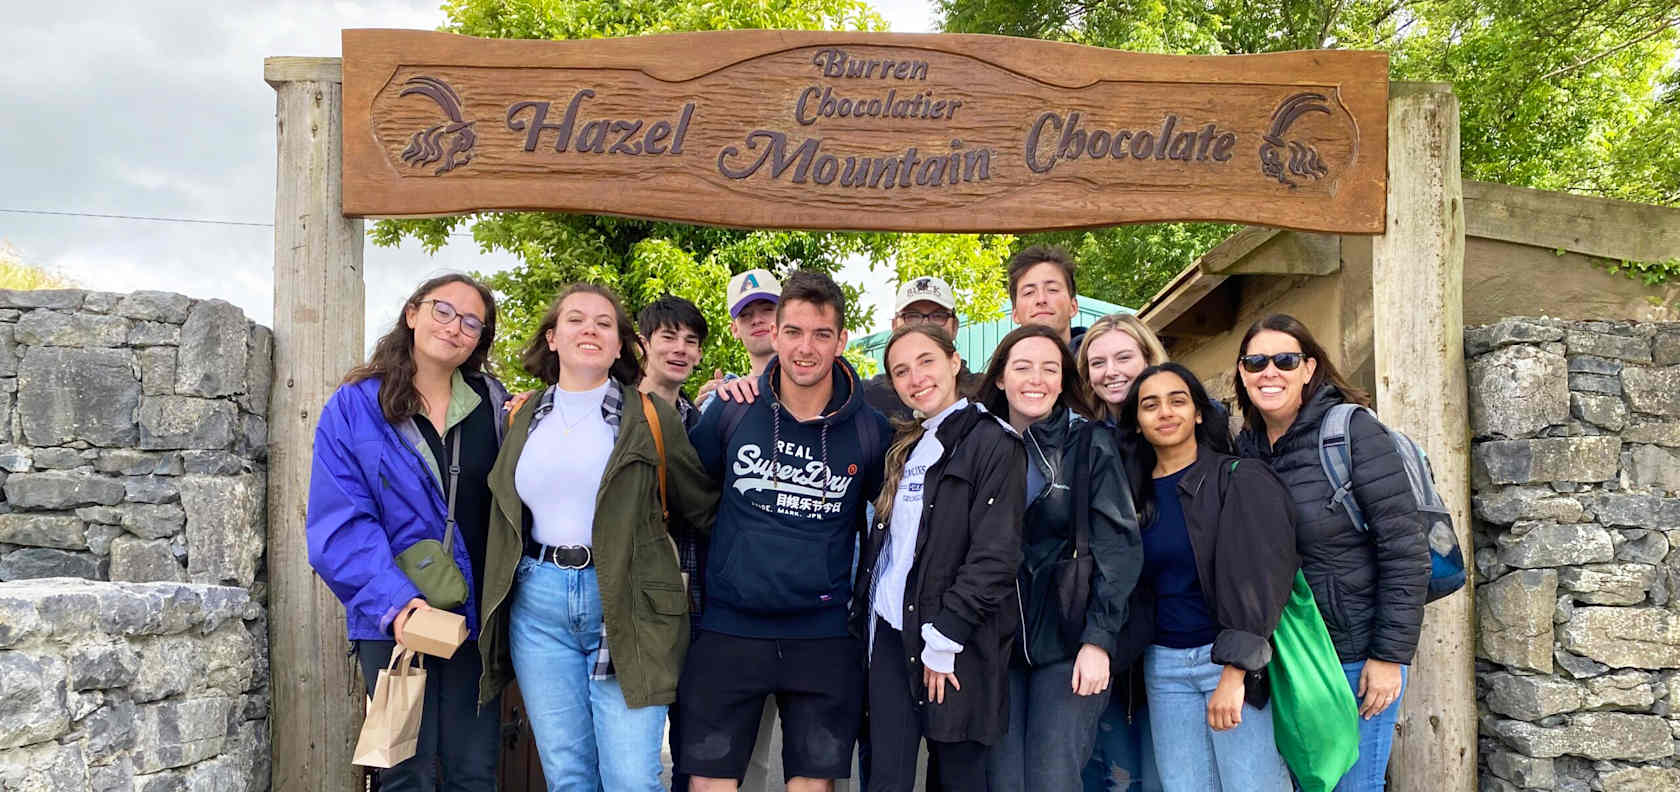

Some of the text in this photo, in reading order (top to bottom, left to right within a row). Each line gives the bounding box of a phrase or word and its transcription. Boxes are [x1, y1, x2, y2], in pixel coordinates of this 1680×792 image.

[813, 47, 929, 82] Burren
[796, 85, 963, 126] Chocolatier
[506, 88, 1237, 191] Hazel Mountain Chocolate
[777, 440, 814, 461] REAL
